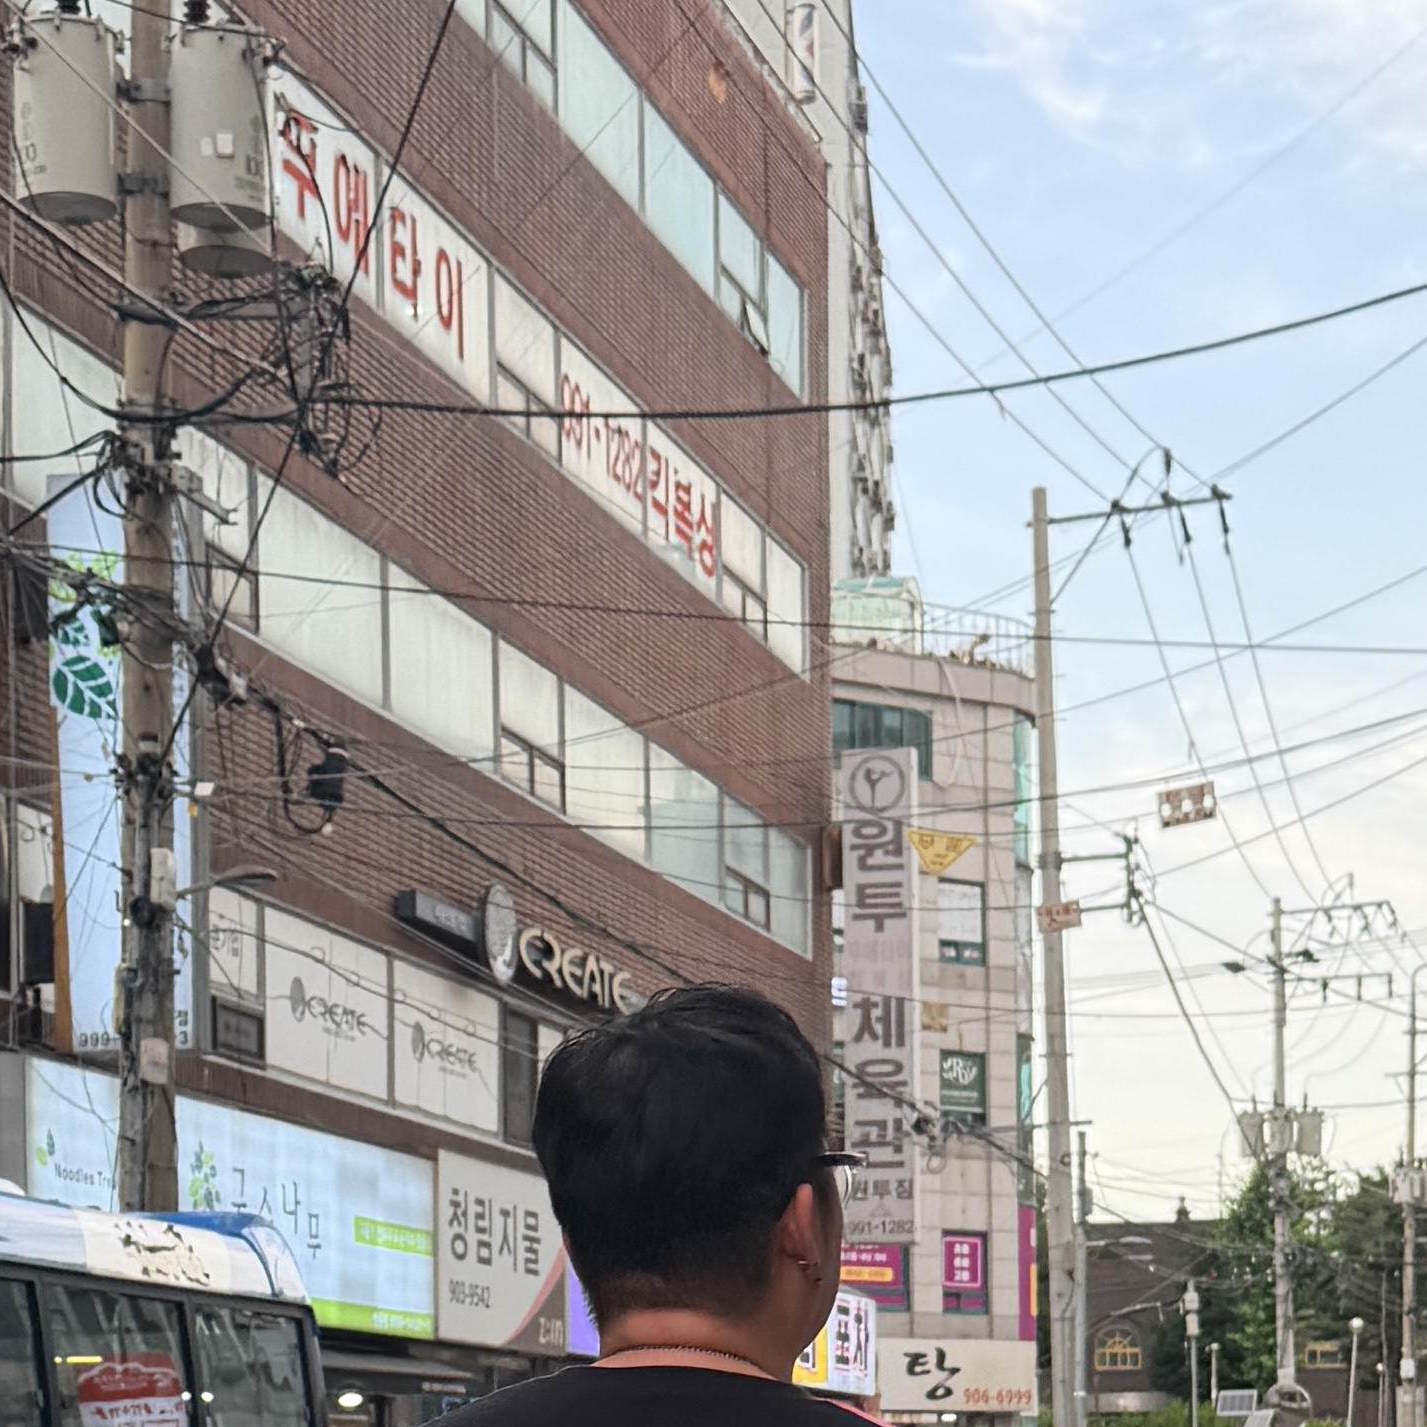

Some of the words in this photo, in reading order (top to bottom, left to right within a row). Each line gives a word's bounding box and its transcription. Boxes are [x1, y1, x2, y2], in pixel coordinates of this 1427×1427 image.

[849, 819, 907, 934] 원투
[518, 927, 637, 1016] CREATE
[850, 996, 910, 1169] 체육관
[448, 1187, 541, 1277] 청림지물
[903, 1346, 961, 1401] 탕
